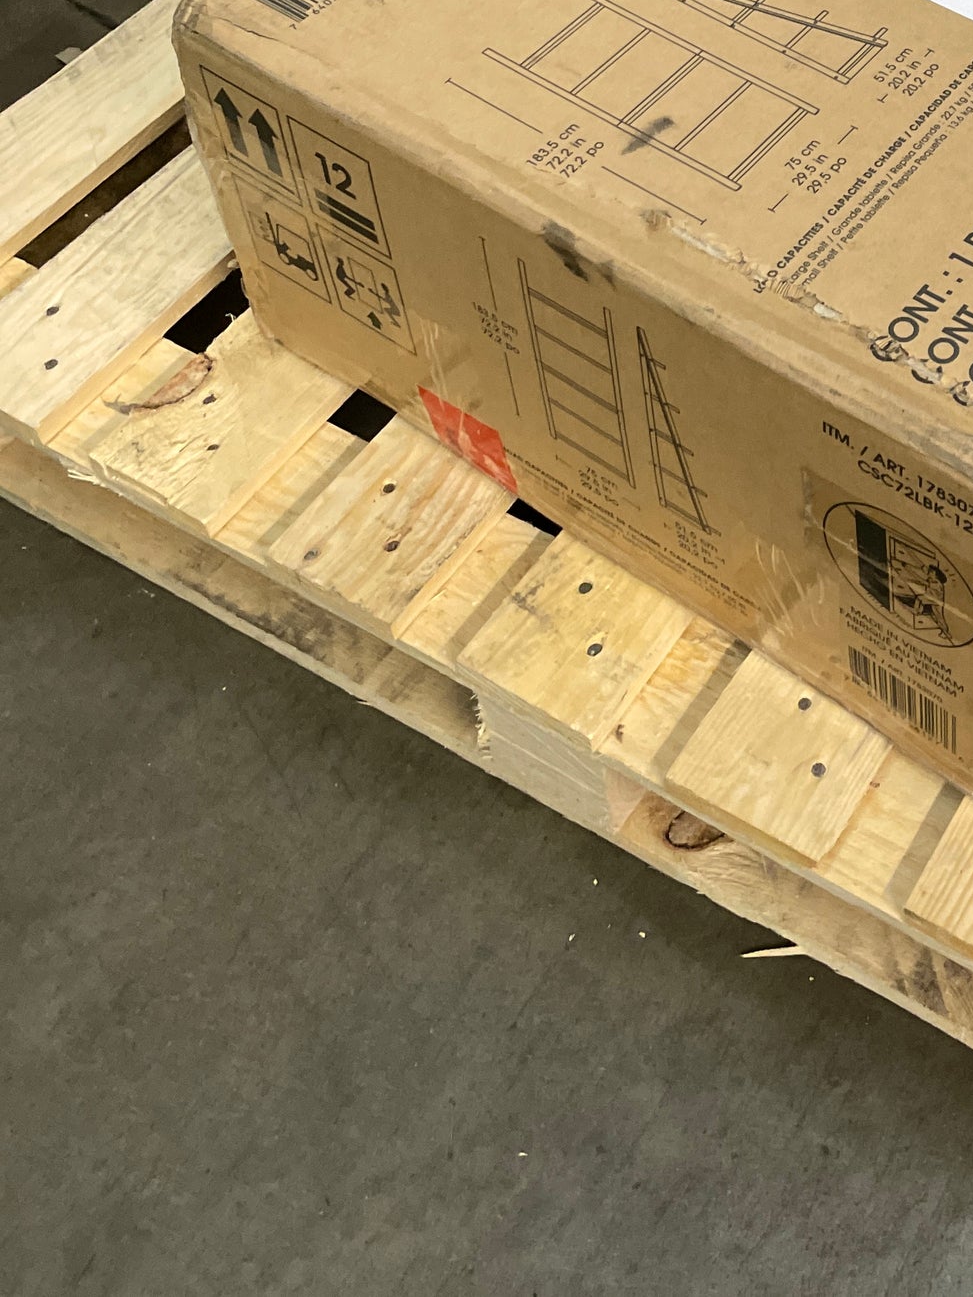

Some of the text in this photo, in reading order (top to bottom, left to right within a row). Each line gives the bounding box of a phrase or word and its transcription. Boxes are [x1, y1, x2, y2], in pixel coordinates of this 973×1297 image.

[872, 47, 913, 83] 51.5 cm
[887, 60, 922, 90] 20.2 in
[901, 62, 939, 96] 20,2 po
[525, 123, 580, 166] 183.5 cm
[545, 137, 586, 170] 72.2 in
[559, 140, 605, 178] 72,2 po
[783, 139, 821, 170] 75 cm
[313, 151, 357, 200] 12
[776, 221, 824, 269] CAPACITIES
[826, 176, 867, 216] CAPACITÉ
[862, 166, 877, 179] DE
[873, 136, 907, 168] CHARGE
[908, 88, 952, 131] CAPACIDAD
[948, 78, 962, 90] DE
[791, 153, 829, 186] 29.5 in
[806, 156, 847, 194] 29,5 po
[868, 283, 953, 363] CONT.
[822, 420, 854, 450] ITM.
[859, 445, 868, 456] /
[872, 452, 909, 480] ART.
